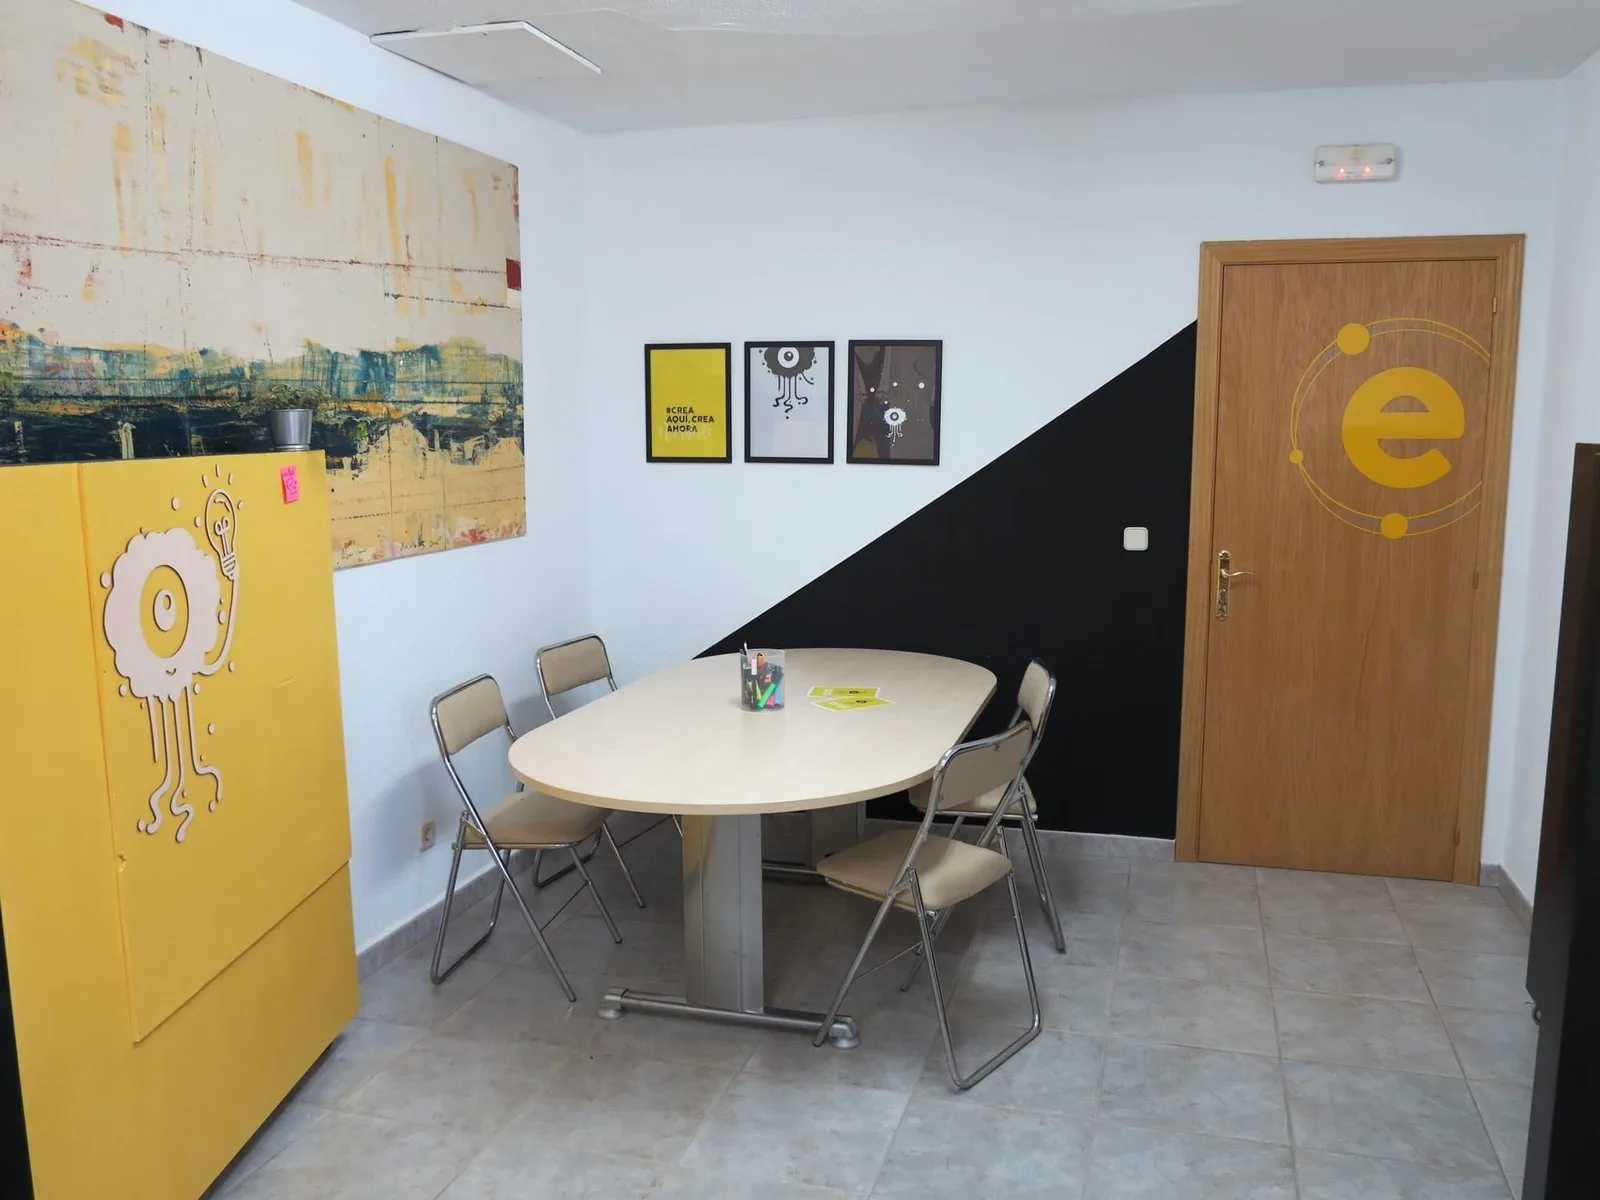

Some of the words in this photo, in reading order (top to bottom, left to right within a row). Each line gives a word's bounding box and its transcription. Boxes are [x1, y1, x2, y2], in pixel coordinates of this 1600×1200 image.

[666, 406, 694, 414] #CREA
[691, 415, 715, 423] CREA
[1342, 366, 1465, 488] e
